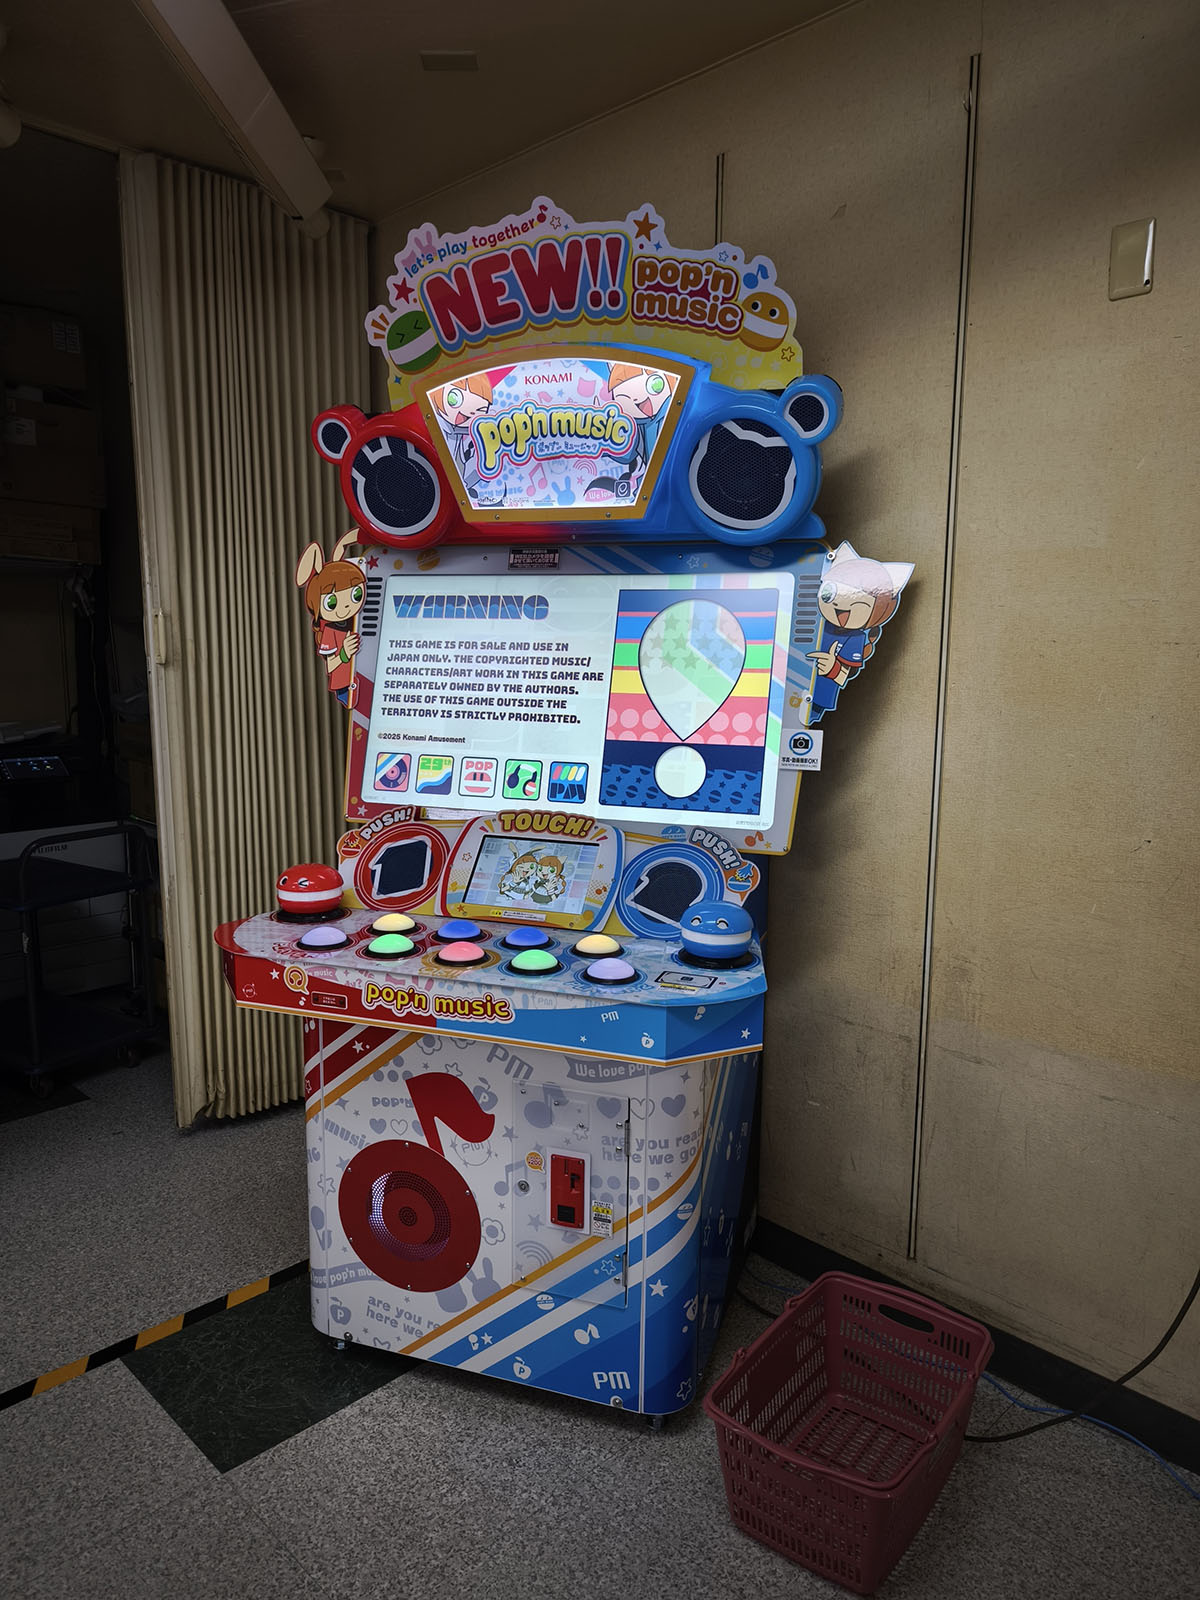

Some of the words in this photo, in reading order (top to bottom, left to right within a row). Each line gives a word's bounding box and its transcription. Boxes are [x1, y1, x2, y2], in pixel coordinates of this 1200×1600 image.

[404, 254, 434, 278] let's
[437, 241, 468, 262] play
[472, 218, 535, 249] together
[637, 257, 735, 294] pop'n
[424, 236, 623, 343] NEW!!
[635, 291, 742, 330] music
[524, 372, 573, 385] KONAMI
[479, 406, 548, 469] pop'n
[551, 409, 628, 444] music
[393, 595, 549, 620] WARNING
[389, 640, 413, 648] THIS
[415, 640, 442, 648] GAME
[444, 641, 456, 649] IS
[458, 641, 478, 649] FOR
[480, 642, 506, 650] SALE
[509, 642, 530, 650] AND
[533, 643, 553, 651] USE
[555, 643, 568, 651] IN
[387, 654, 420, 662] JAPAN
[422, 654, 451, 663] ONLY.
[454, 655, 473, 663] THE
[476, 656, 549, 665] COPYRIGHTED
[552, 657, 591, 667] MUSIC/
[386, 667, 472, 677] CHARACTERS/ART
[475, 669, 503, 678] WORK
[506, 670, 519, 678] IN
[522, 671, 548, 679] THIS
[551, 671, 580, 680] GAME
[582, 672, 604, 681] ARE
[384, 681, 447, 690] SEPARATELY
[450, 682, 484, 691] OWNED
[487, 684, 500, 692] BY
[503, 684, 523, 693] THE
[525, 685, 578, 694] AUTHORS.
[383, 694, 401, 702] THE
[404, 695, 422, 703] USE
[425, 695, 437, 703] OF
[440, 696, 464, 704] THIS
[467, 697, 494, 706] GAME
[497, 698, 544, 708] OUTSIDE
[547, 700, 567, 708] THE
[381, 708, 438, 717] TERRITORY
[440, 710, 452, 718] IS
[455, 711, 506, 720] STRICTLY
[508, 713, 580, 723] PROHIBITED.
[402, 734, 426, 742] Konami
[428, 735, 466, 743] Amusement
[465, 760, 493, 771] POP
[360, 807, 413, 841] PUSH!
[501, 813, 595, 838] TOUCH!
[692, 829, 743, 870] PUSH!
[366, 983, 428, 1011] pop'n
[434, 994, 510, 1018] music
[575, 1063, 596, 1078] We
[598, 1064, 625, 1077] love
[635, 1138, 669, 1151] you
[602, 1147, 642, 1163] hee
[648, 1153, 674, 1165] we
[330, 1267, 356, 1285] pop'n
[368, 1295, 390, 1311] are
[395, 1308, 422, 1326] you
[366, 1306, 398, 1328] here
[402, 1322, 424, 1338] we
